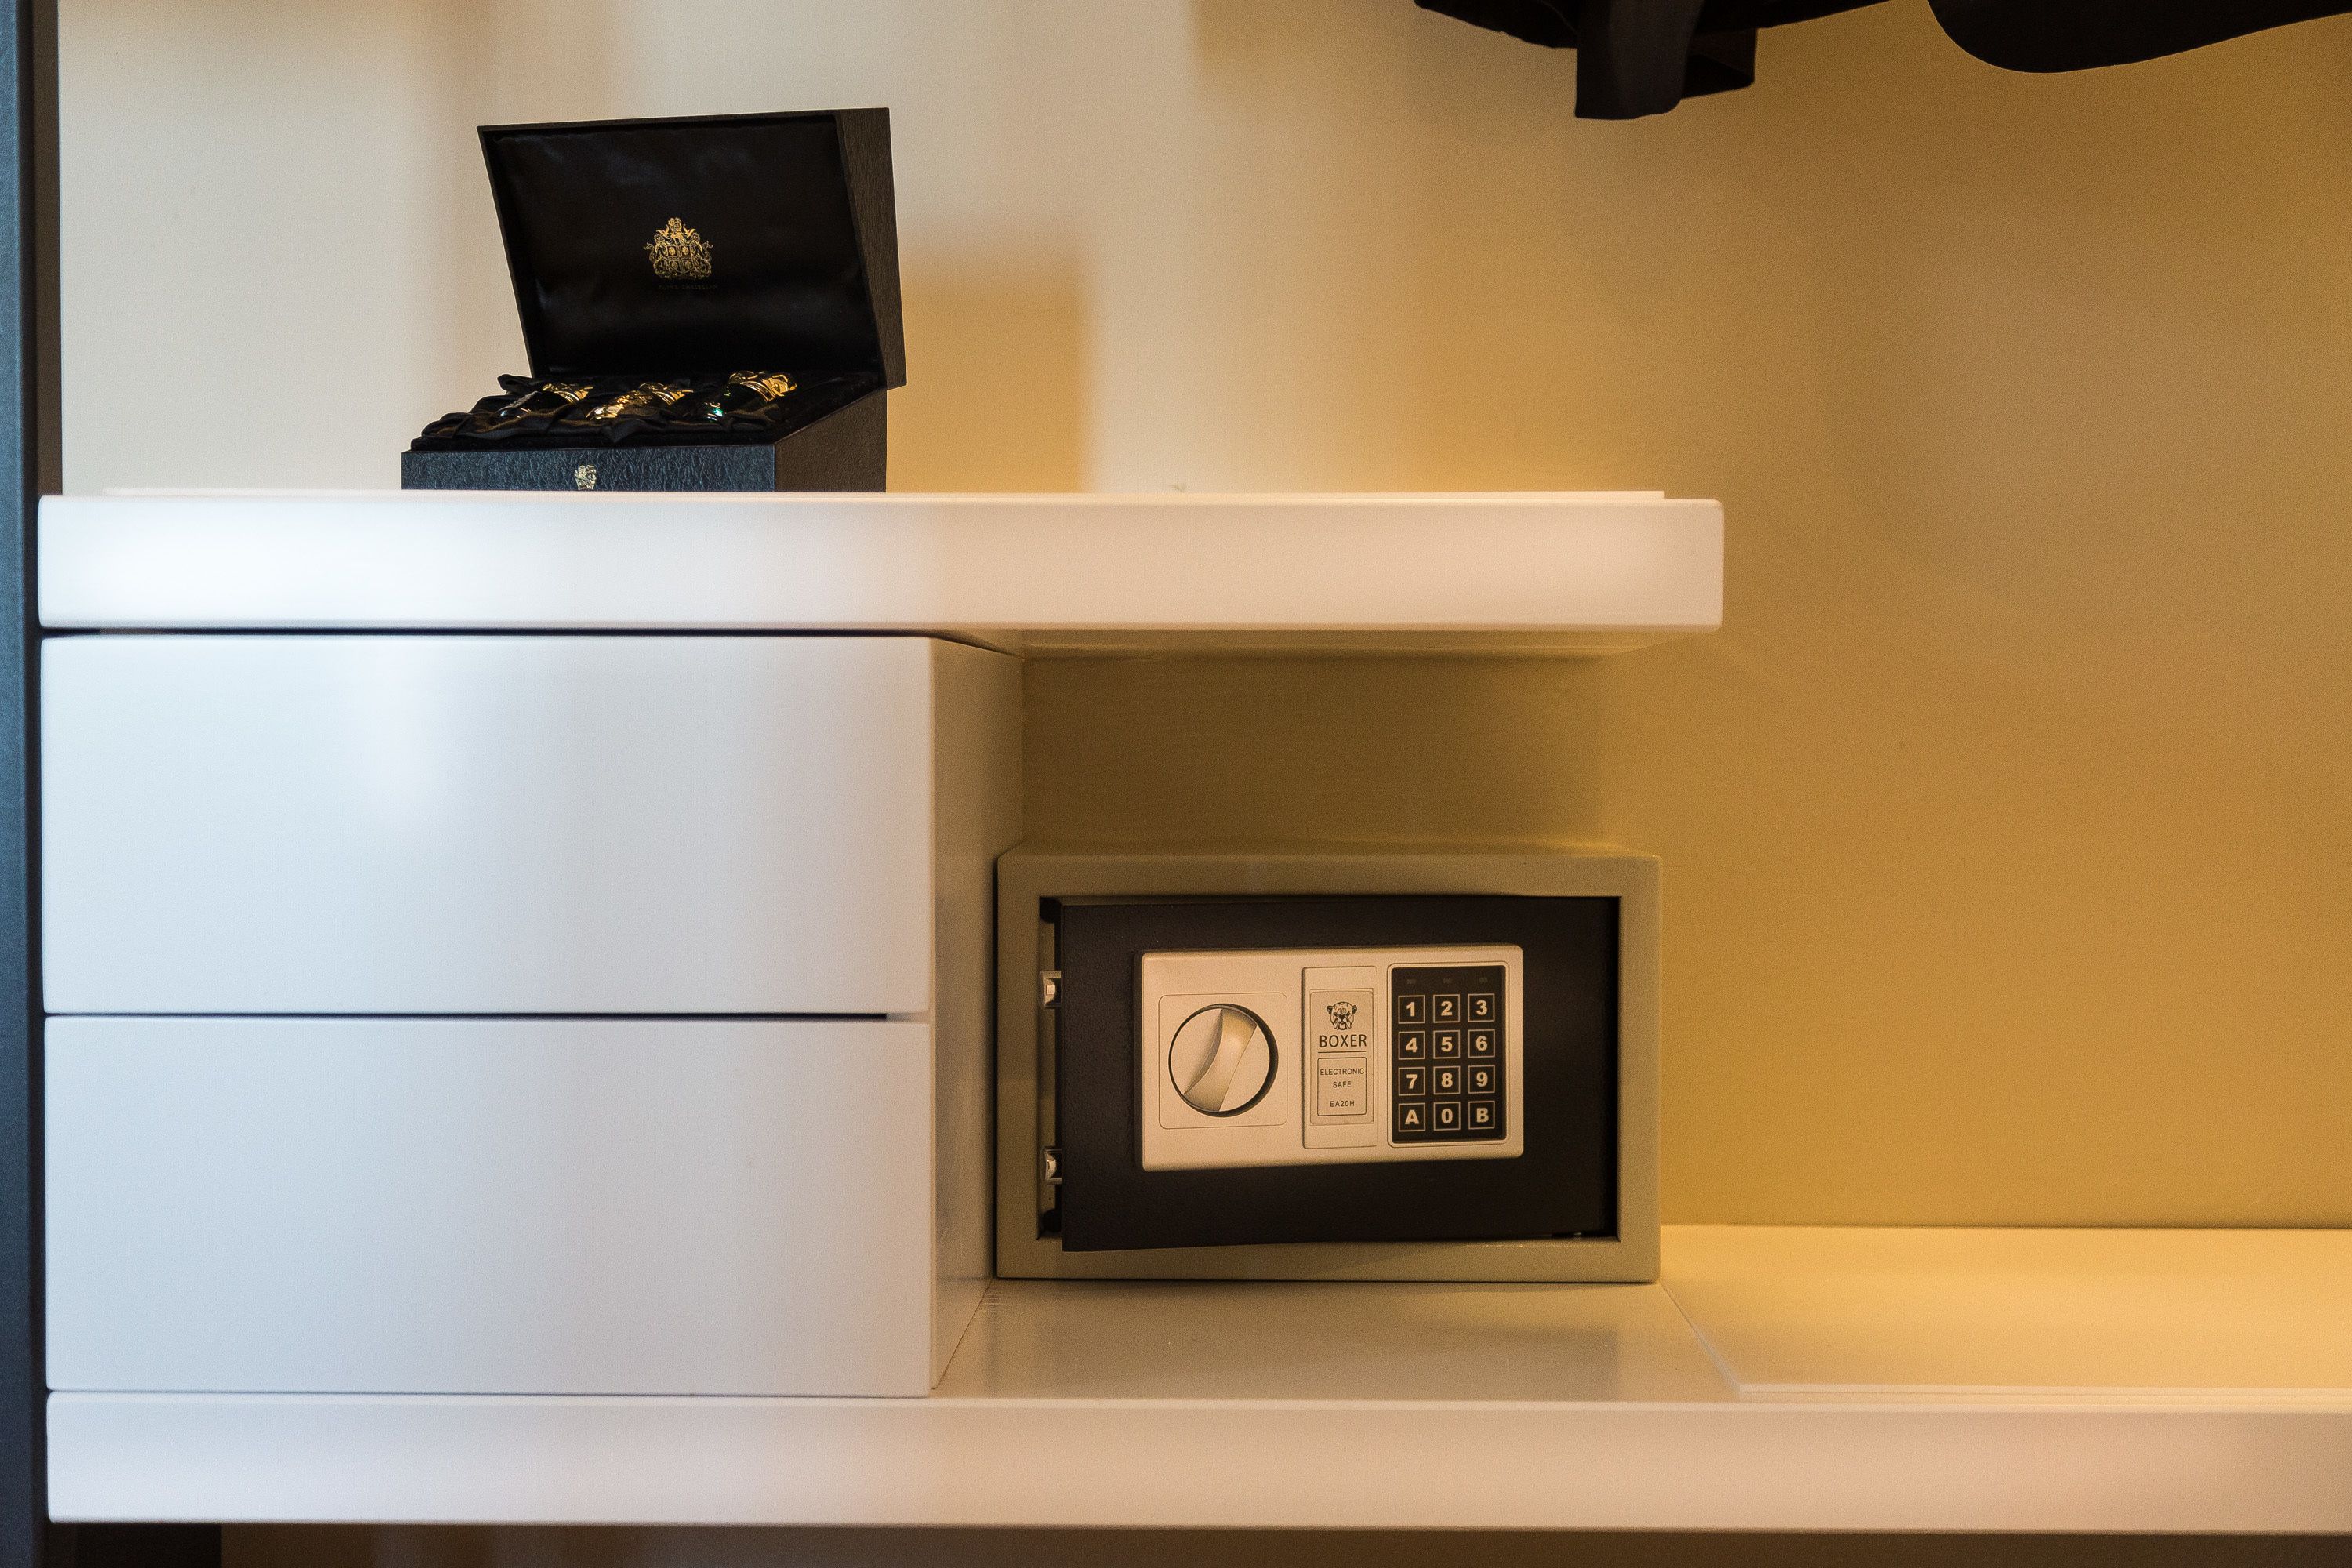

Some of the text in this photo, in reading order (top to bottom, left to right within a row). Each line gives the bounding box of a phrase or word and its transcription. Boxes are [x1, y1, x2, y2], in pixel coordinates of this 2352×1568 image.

[1406, 1000, 1488, 1016] 1 2 3
[1319, 1034, 1367, 1047] BOXER
[1405, 1036, 1488, 1052] 4 5 6
[1319, 1067, 1365, 1076] ELECTRONIC
[1332, 1080, 1352, 1089] SAFE
[1406, 1072, 1488, 1089] 7 8 9
[1405, 1108, 1489, 1124] A 0 B
